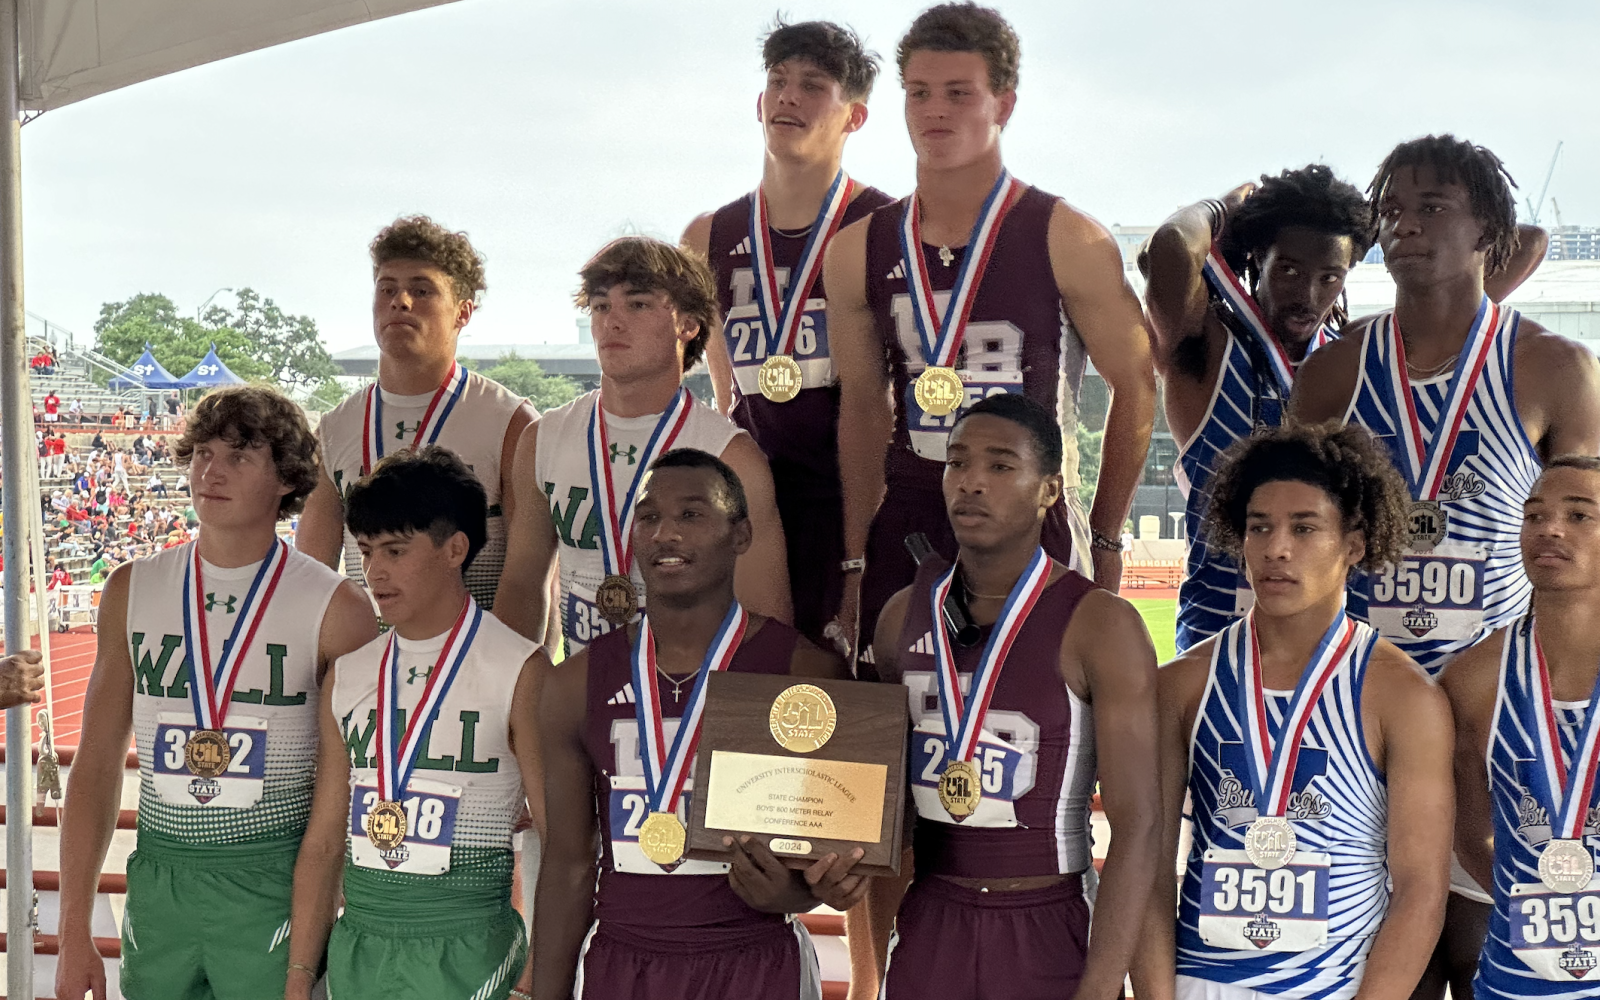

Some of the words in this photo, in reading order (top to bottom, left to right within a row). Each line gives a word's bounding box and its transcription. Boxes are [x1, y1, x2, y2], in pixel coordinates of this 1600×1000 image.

[731, 315, 817, 361] 276
[1374, 561, 1476, 604] 3590
[1403, 617, 1438, 627] STATE
[788, 729, 815, 738] STATE
[164, 728, 253, 774] 32
[188, 784, 221, 794] STATE
[736, 768, 773, 794] UNIVERSITY
[774, 767, 835, 785] INTERSCHOLASTIC
[833, 779, 857, 804] LEAGUE
[788, 795, 824, 804] CHAMPION
[360, 791, 445, 840] 318
[789, 807, 811, 815] METER
[812, 809, 834, 817] RELAY
[764, 817, 808, 827] CONFERENCE
[809, 820, 823, 828] AAA
[778, 841, 802, 851] 2024
[1213, 867, 1316, 914] 3591
[1243, 927, 1281, 937] STATE
[1560, 957, 1597, 967] STATE
